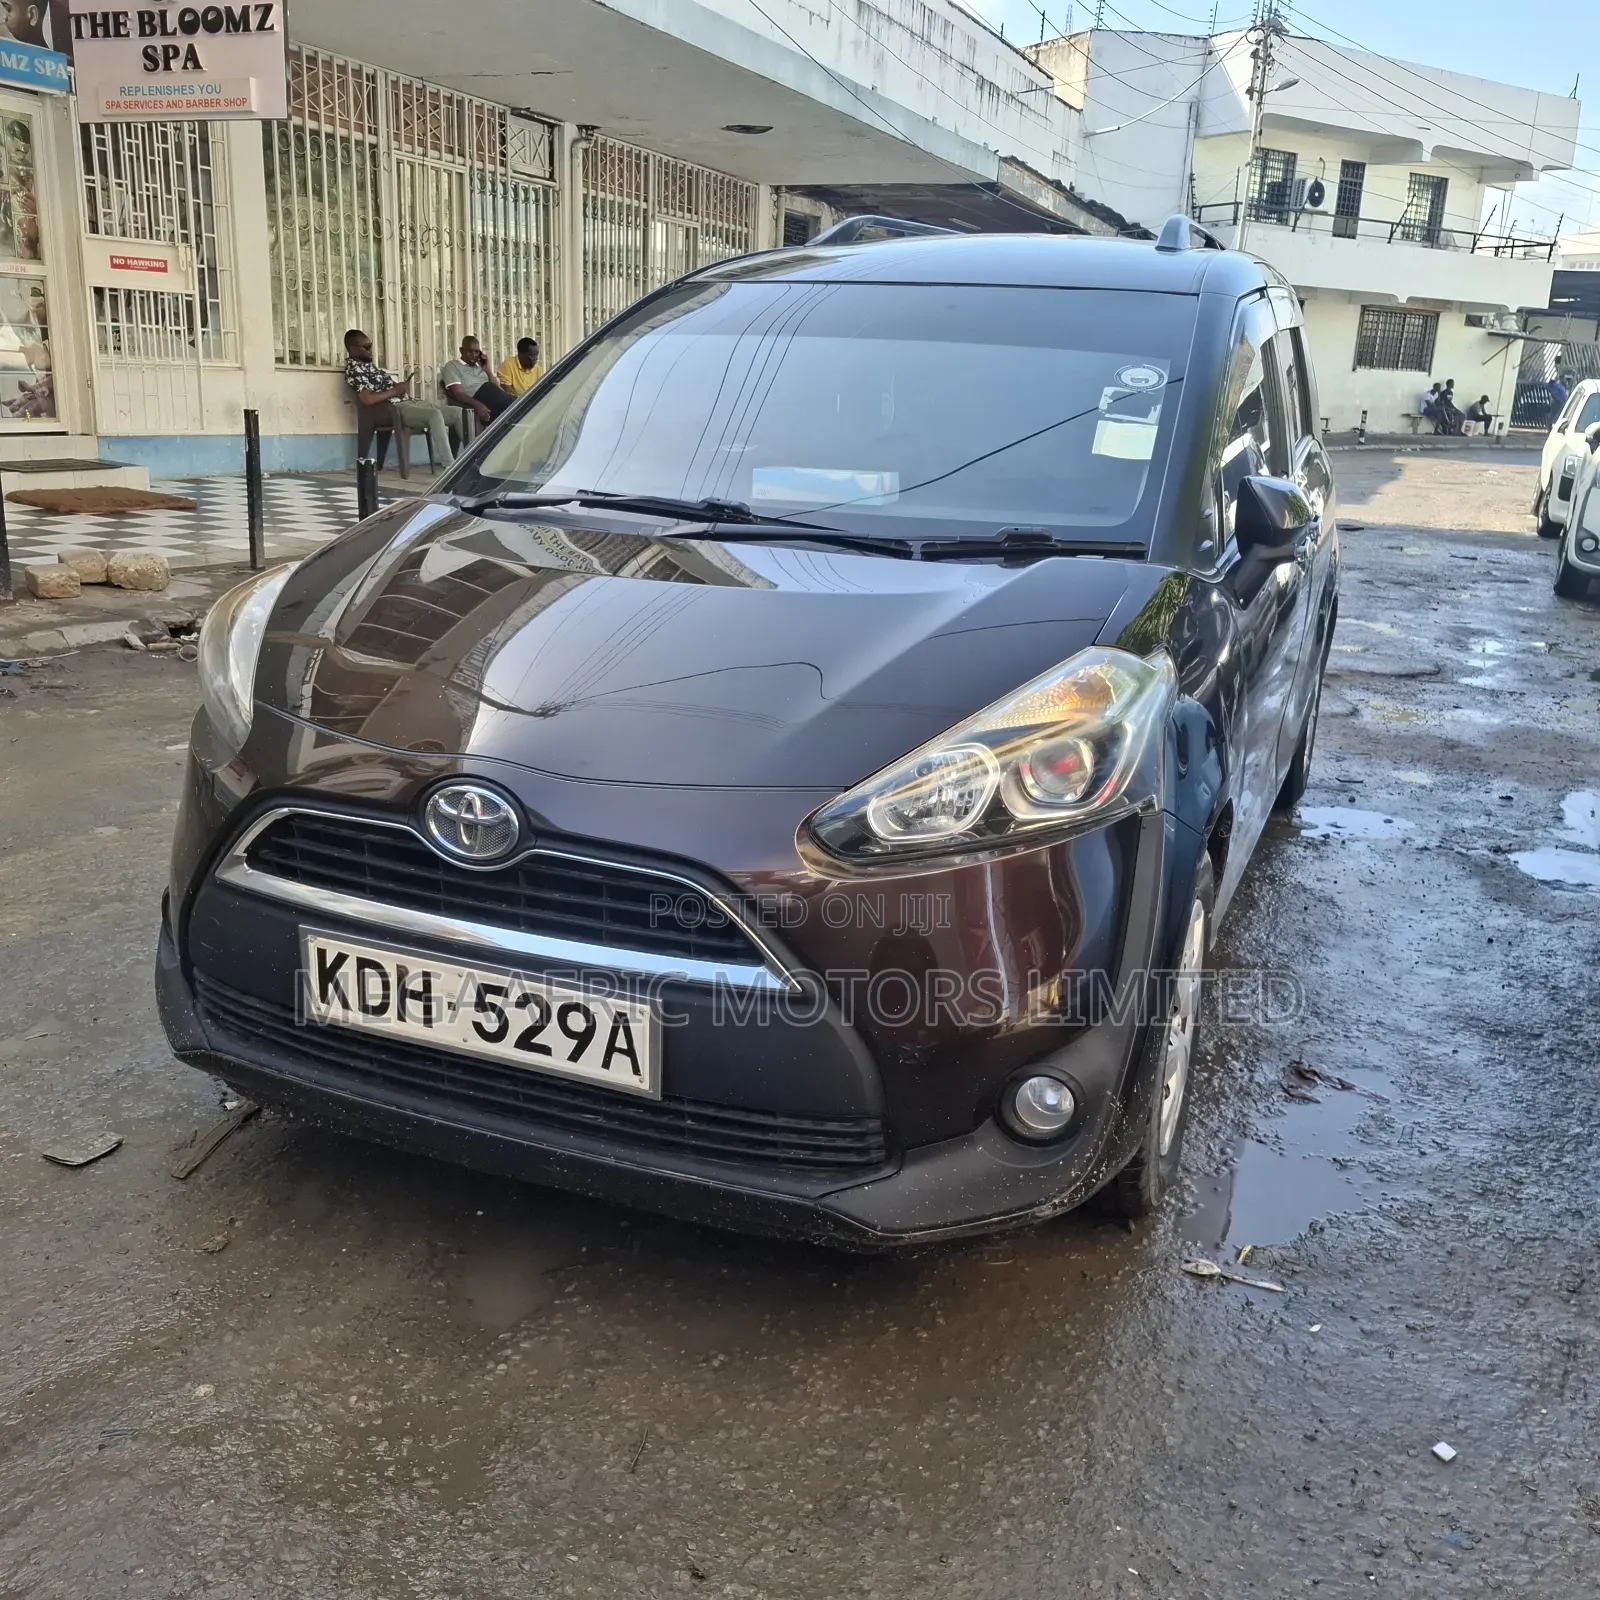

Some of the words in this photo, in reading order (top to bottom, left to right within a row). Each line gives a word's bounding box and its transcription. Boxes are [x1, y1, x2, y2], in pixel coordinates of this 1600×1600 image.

[70, 10, 131, 39] THE
[136, 3, 275, 38] BLOOMZ
[34, 57, 69, 80] SPA
[141, 43, 204, 72] SPA
[119, 84, 195, 97] REPLENISHES
[197, 83, 222, 95] YOU
[105, 100, 122, 110] SPA
[123, 99, 164, 110] SERVICES
[165, 99, 184, 109] AND
[186, 98, 222, 108] BARBER
[223, 97, 248, 107] SHOP
[112, 257, 125, 265] NO
[126, 258, 165, 268] HAWKING
[316, 946, 435, 1029] KDH
[472, 982, 643, 1076] 529A
